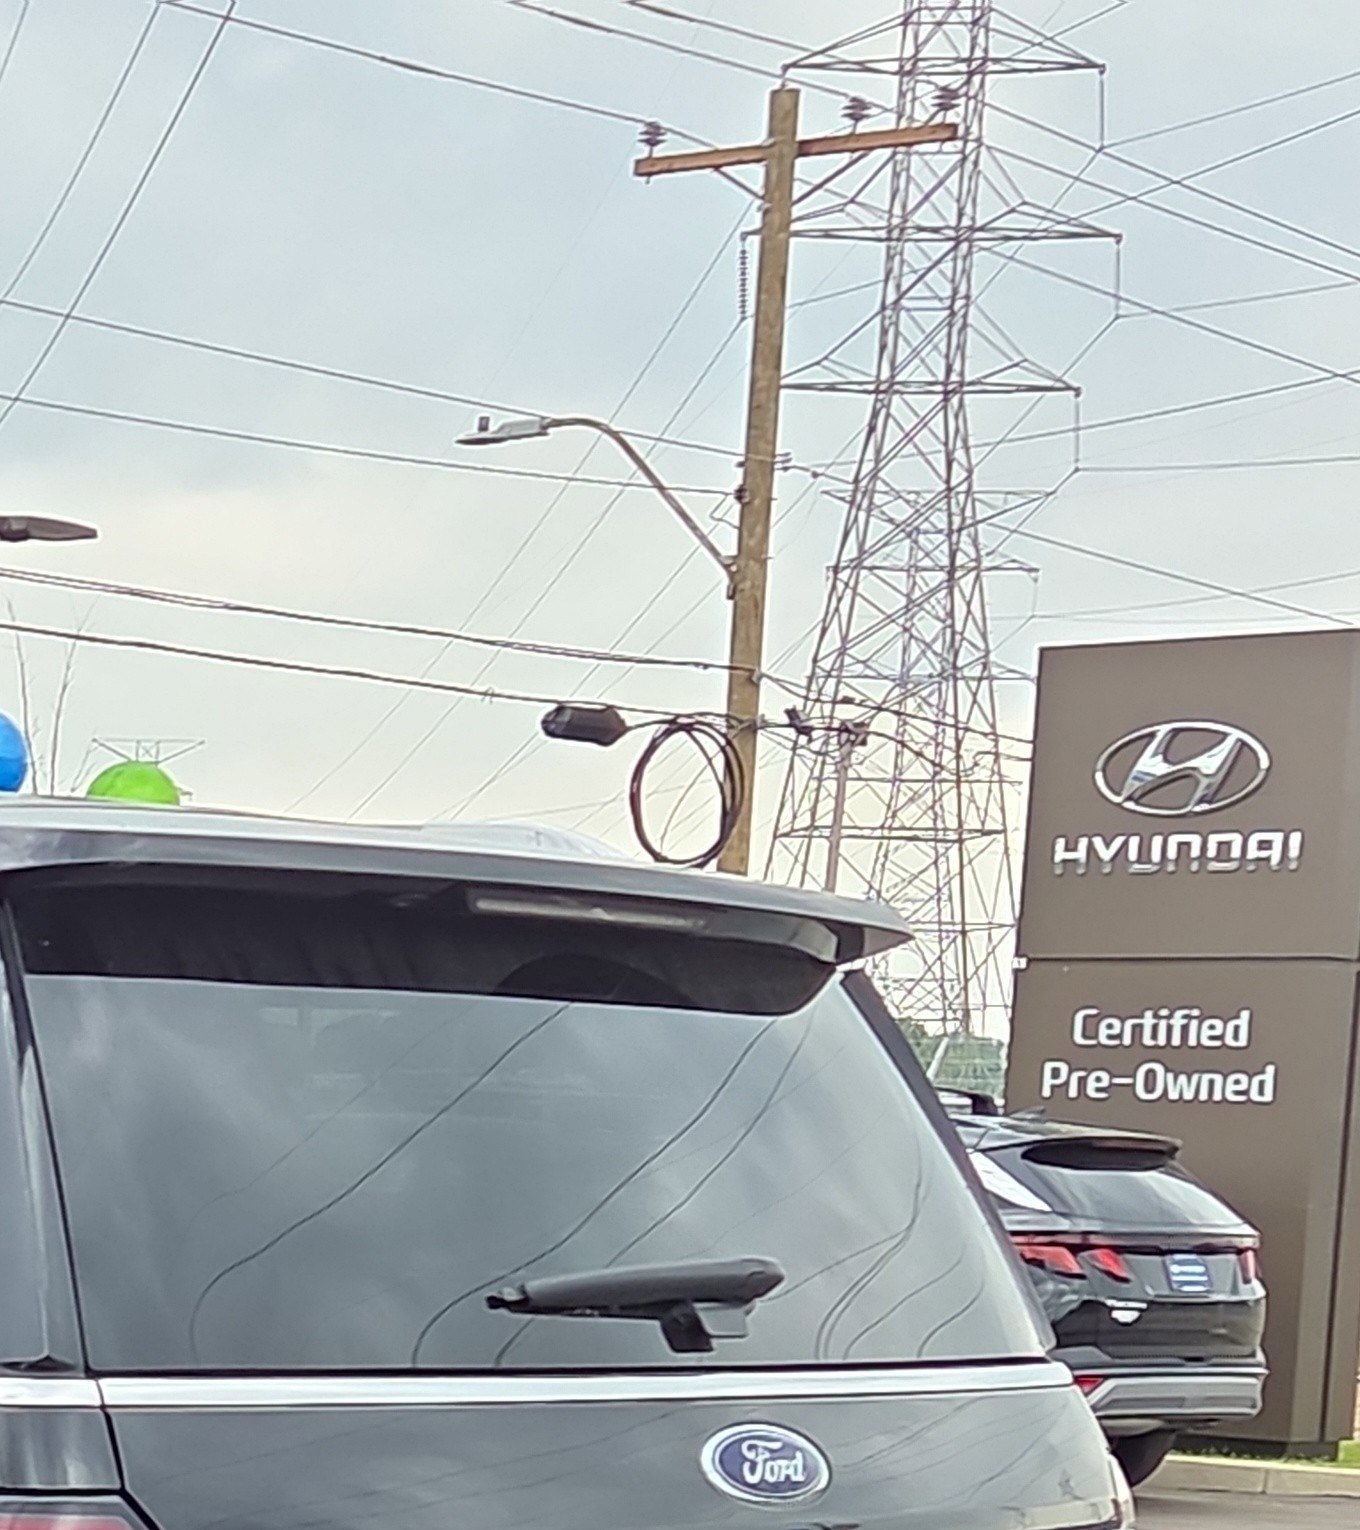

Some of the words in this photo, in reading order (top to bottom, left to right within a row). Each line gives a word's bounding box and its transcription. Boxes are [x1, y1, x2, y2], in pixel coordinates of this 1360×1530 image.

[1052, 830, 1304, 876] HYUNDAI
[1072, 1007, 1251, 1049] Certified
[1041, 1061, 1277, 1103] Pre-Owned
[741, 1439, 805, 1484] Ford
